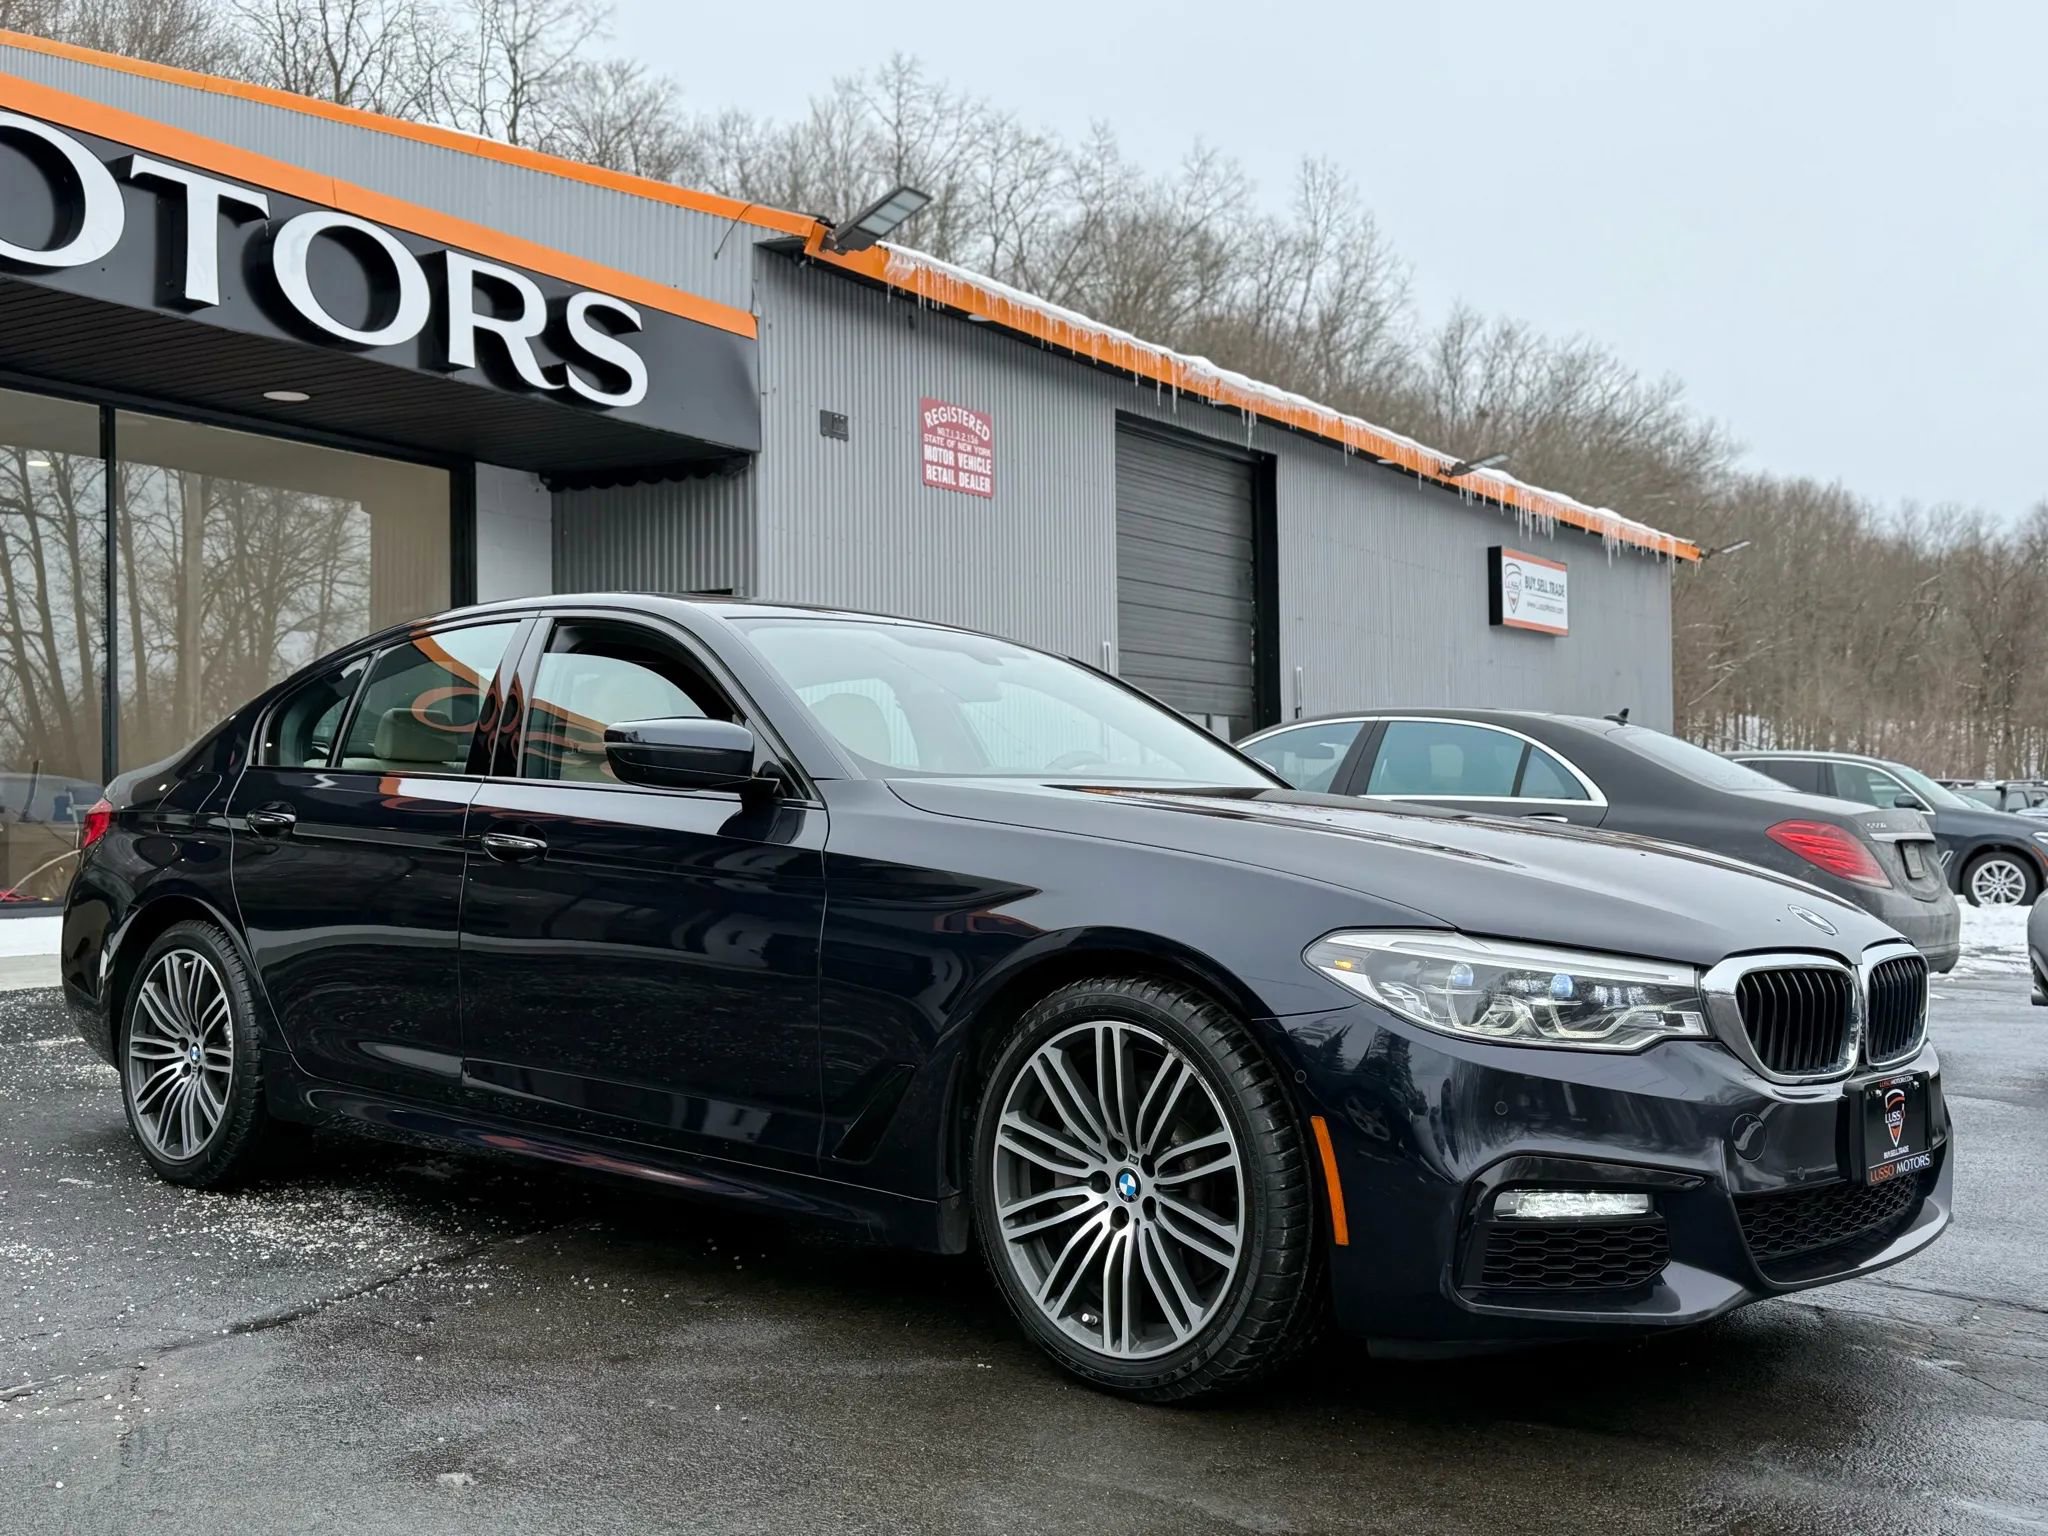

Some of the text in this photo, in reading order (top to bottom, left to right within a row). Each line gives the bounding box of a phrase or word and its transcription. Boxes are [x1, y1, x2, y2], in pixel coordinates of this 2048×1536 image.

[924, 406, 990, 441] REGISTERED
[924, 433, 991, 458] STATE OF NEW YORK
[924, 445, 992, 475] MOTOR VEHICLE
[926, 464, 991, 493] RETAIL DEALER
[1870, 1154, 1930, 1182] LUSSO MOTORS
